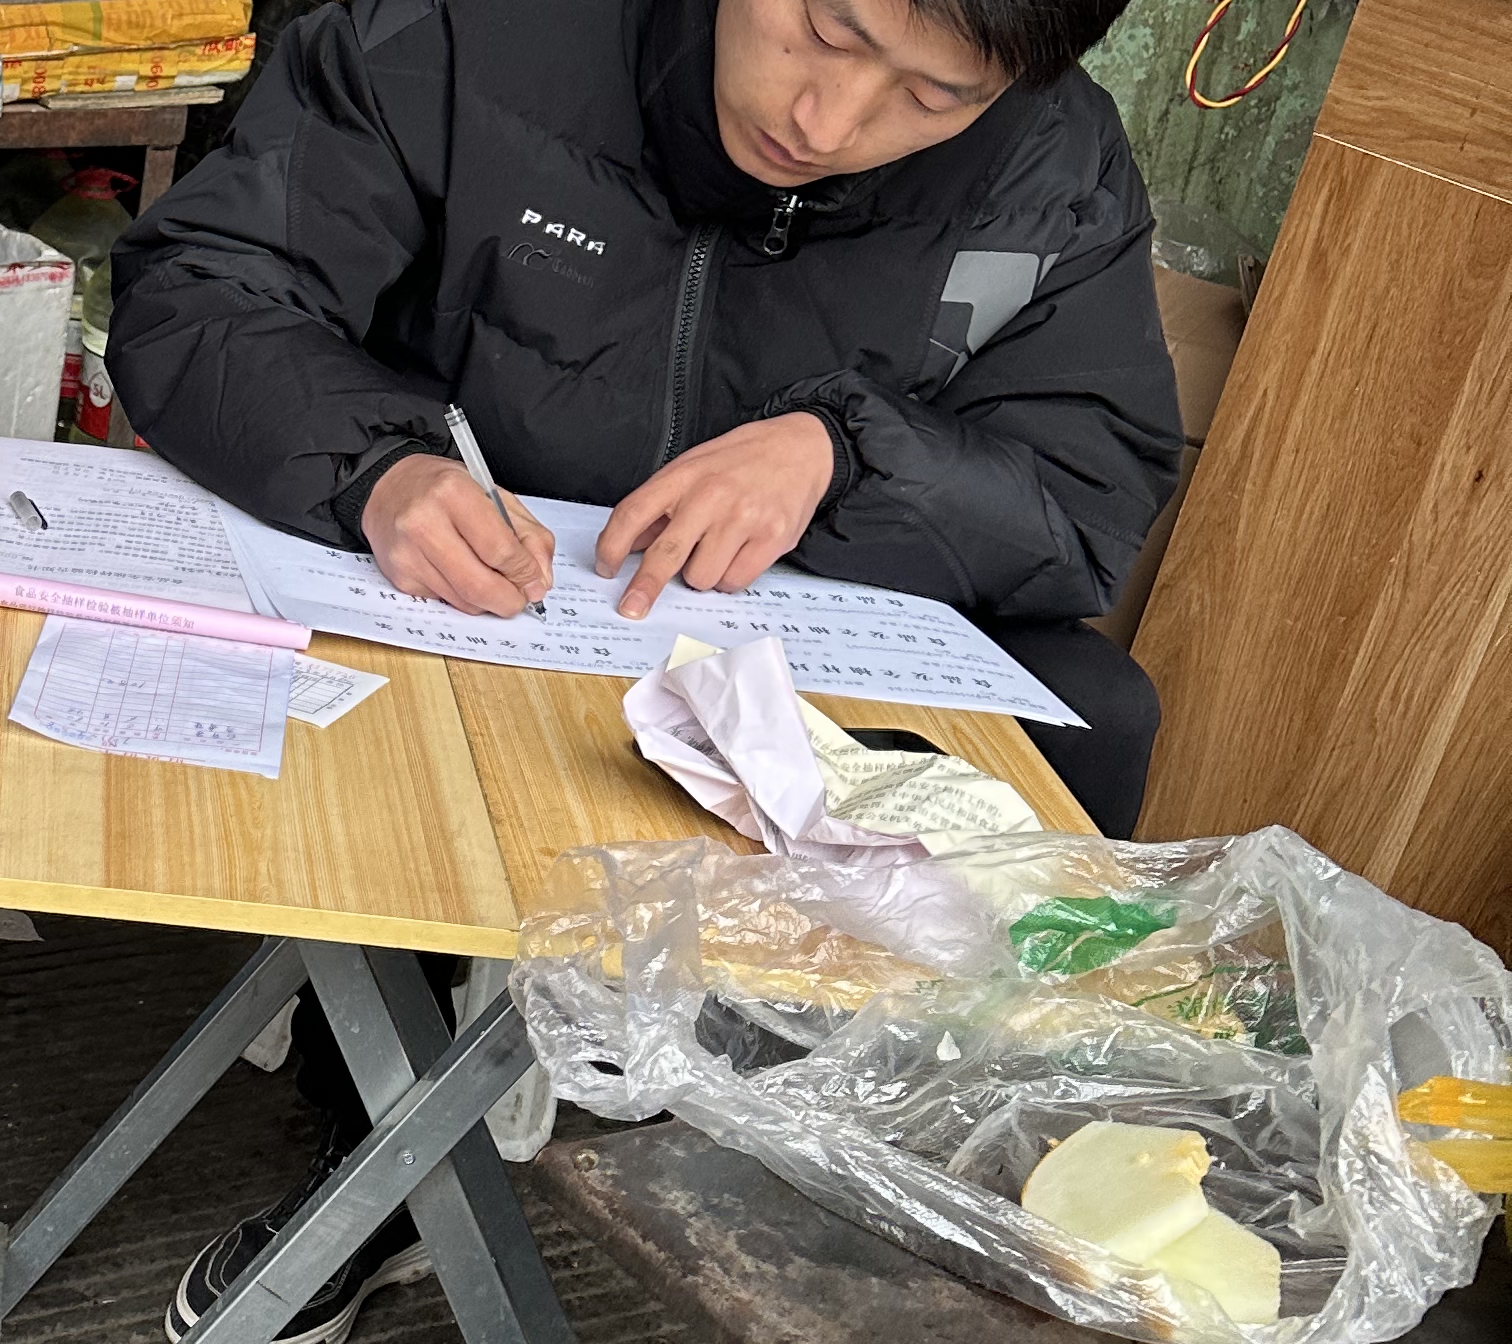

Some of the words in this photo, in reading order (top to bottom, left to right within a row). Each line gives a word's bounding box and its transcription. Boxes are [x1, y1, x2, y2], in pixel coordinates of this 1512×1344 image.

[521, 208, 606, 256] PARA
[14, 583, 196, 632] 食品安全抽样检验被抽样单位须知
[374, 621, 612, 657] 食品安全抽样封条
[719, 620, 946, 647] 食品安全抽样封条
